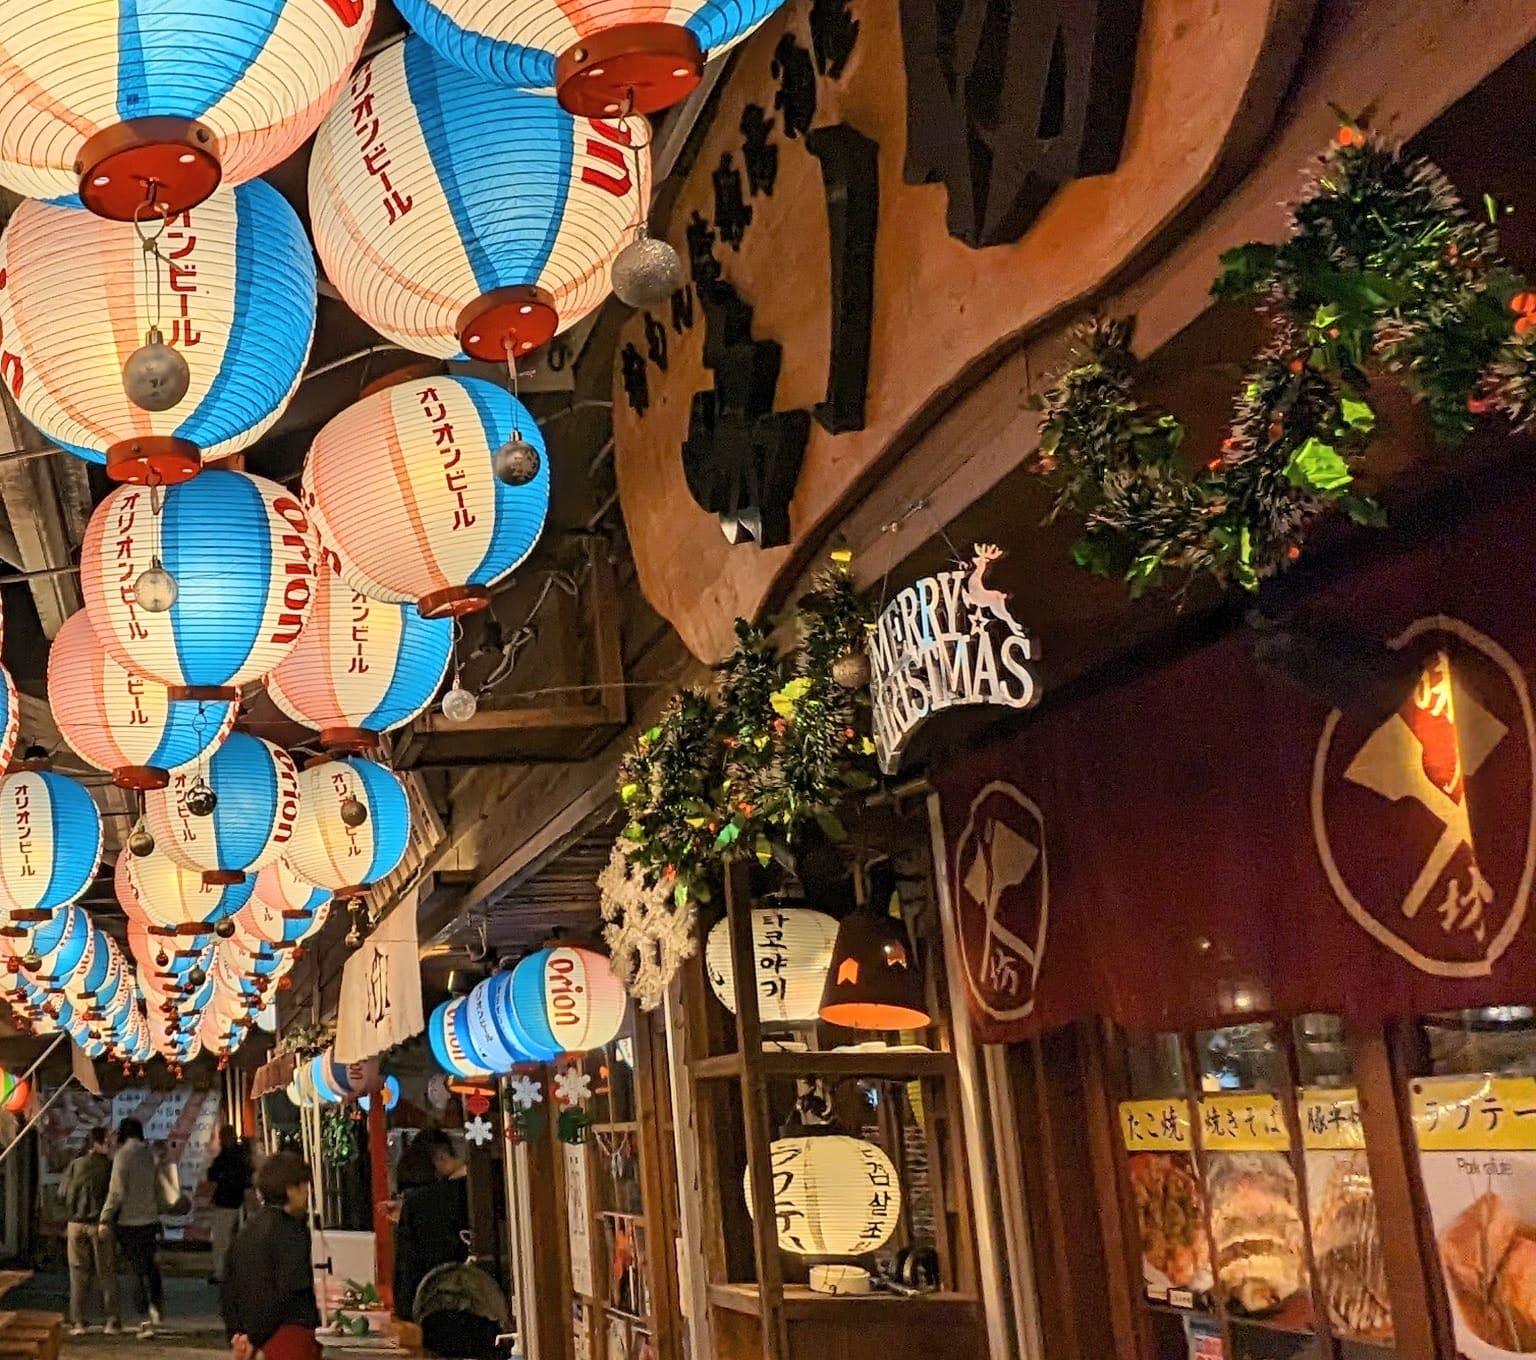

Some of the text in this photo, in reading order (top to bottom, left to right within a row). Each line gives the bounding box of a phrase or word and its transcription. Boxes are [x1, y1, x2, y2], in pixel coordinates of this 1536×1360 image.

[411, 389, 474, 534] オリオンビール
[109, 488, 147, 638] オリオンビール
[869, 570, 964, 685] MERRY
[871, 630, 1034, 775] CHRISTMAS
[14, 785, 35, 877] オリオンビール
